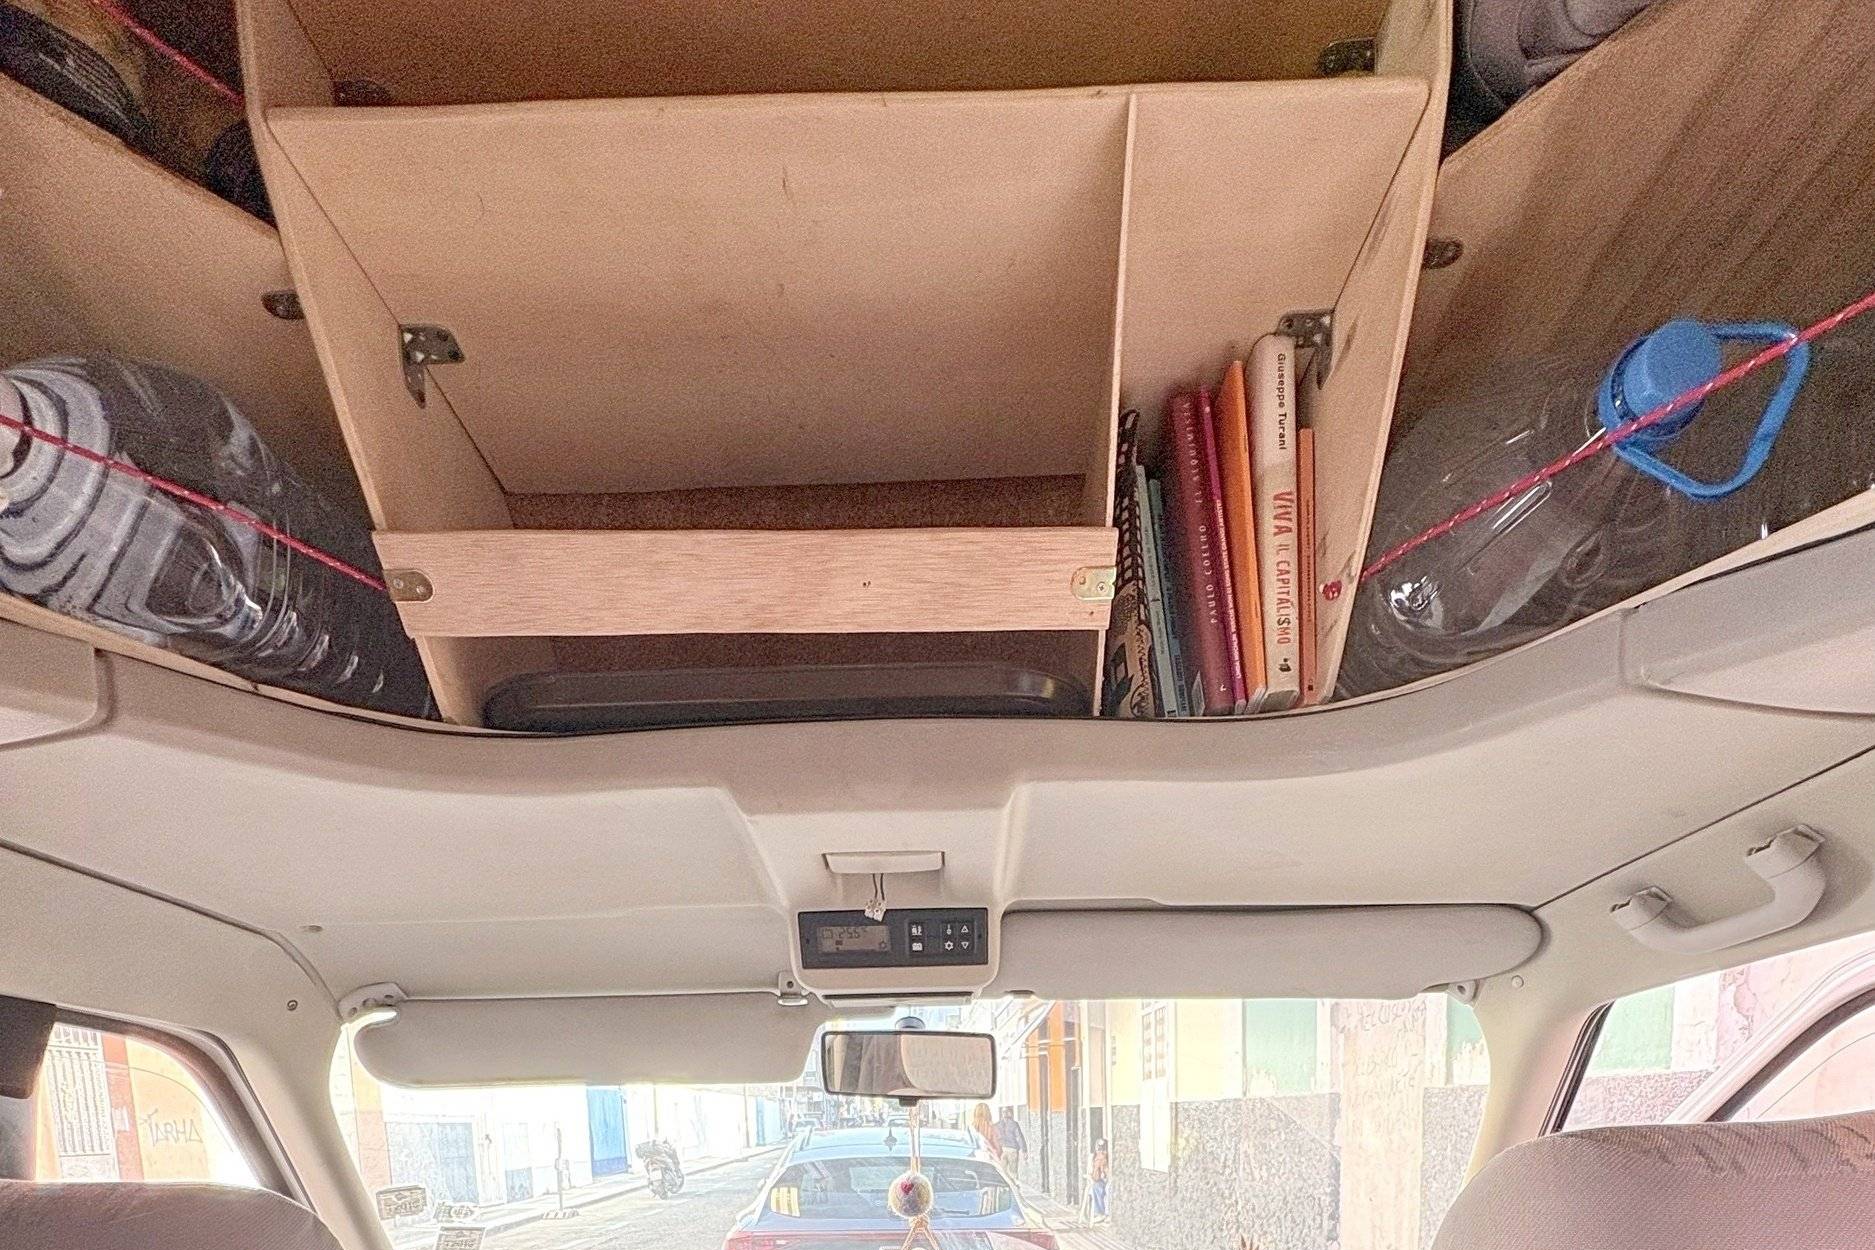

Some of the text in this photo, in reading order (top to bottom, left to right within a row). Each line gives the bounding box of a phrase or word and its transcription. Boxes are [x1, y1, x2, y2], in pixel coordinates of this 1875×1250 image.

[1275, 352, 1287, 450] Giuseppe Turani
[1272, 490, 1294, 537] VIVA
[1275, 543, 1290, 556] IL
[1205, 583, 1218, 623] PAULO
